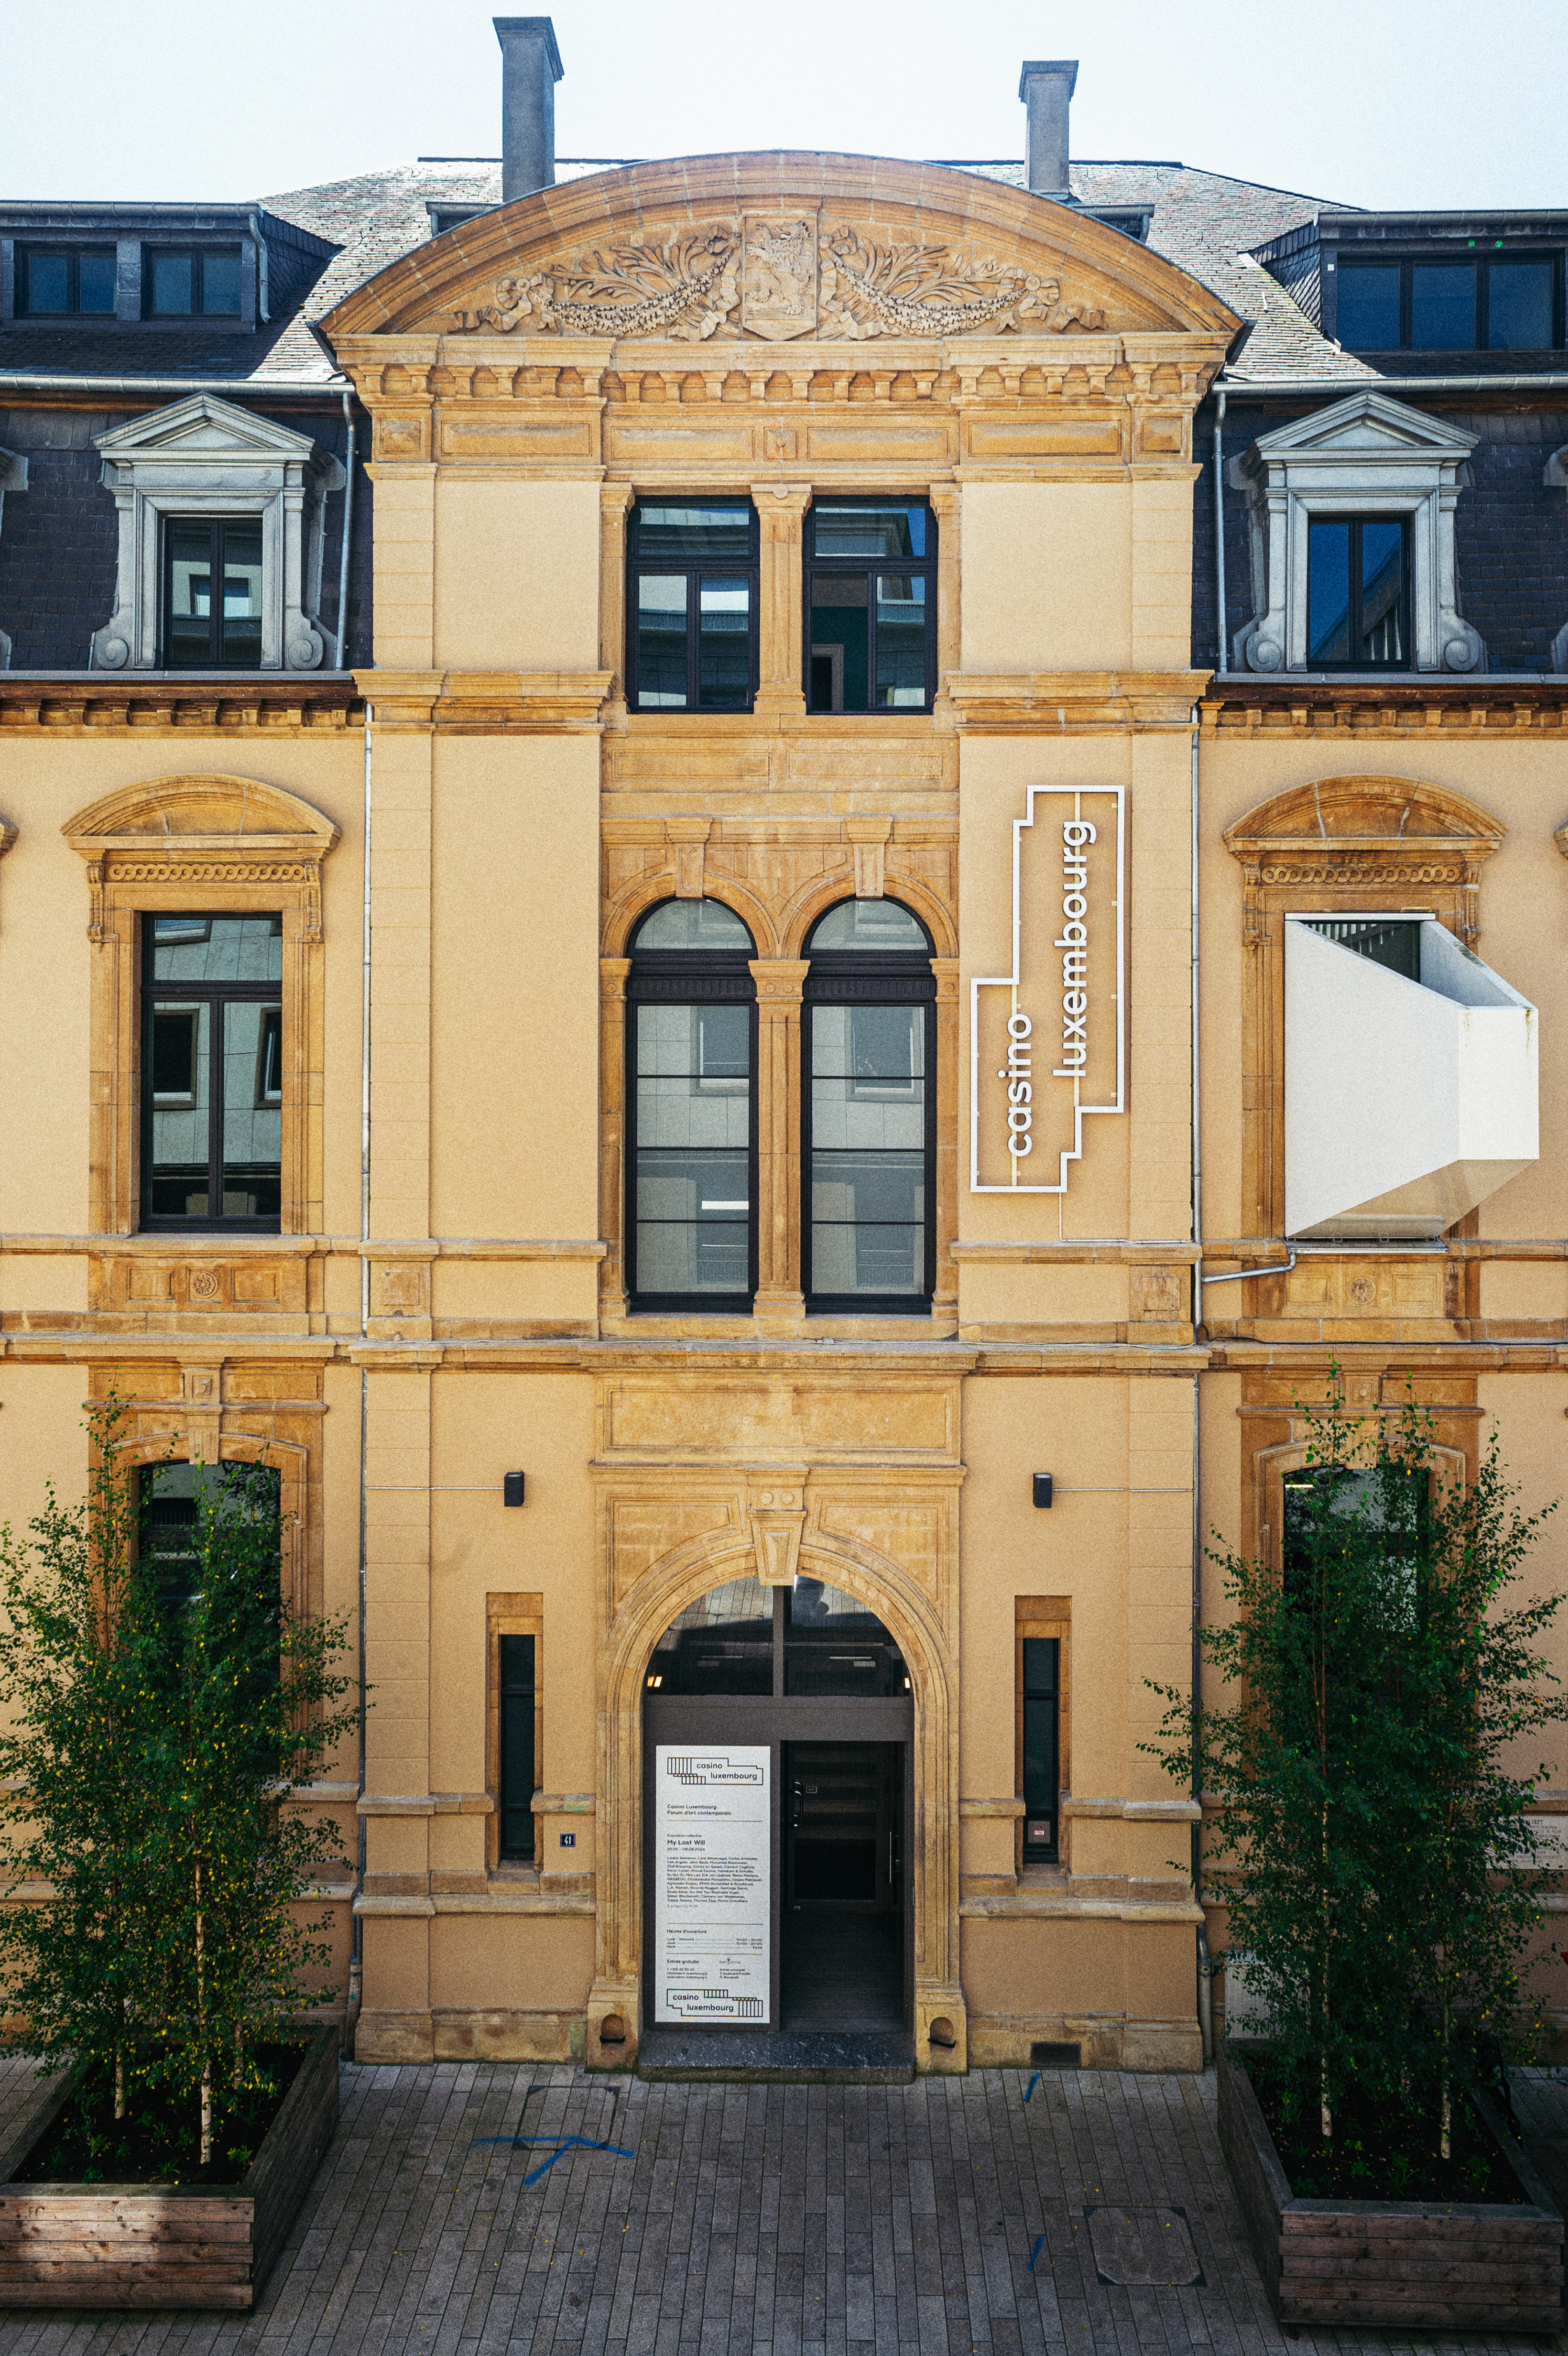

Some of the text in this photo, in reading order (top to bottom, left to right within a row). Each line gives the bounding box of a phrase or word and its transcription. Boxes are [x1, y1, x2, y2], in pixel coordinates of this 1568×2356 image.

[1052, 820, 1097, 1077] luxembourg
[998, 1014, 1033, 1157] casino
[710, 1772, 758, 1780] luxembourg
[564, 1835, 572, 1845] 41
[687, 2004, 734, 2012] luxembourg
